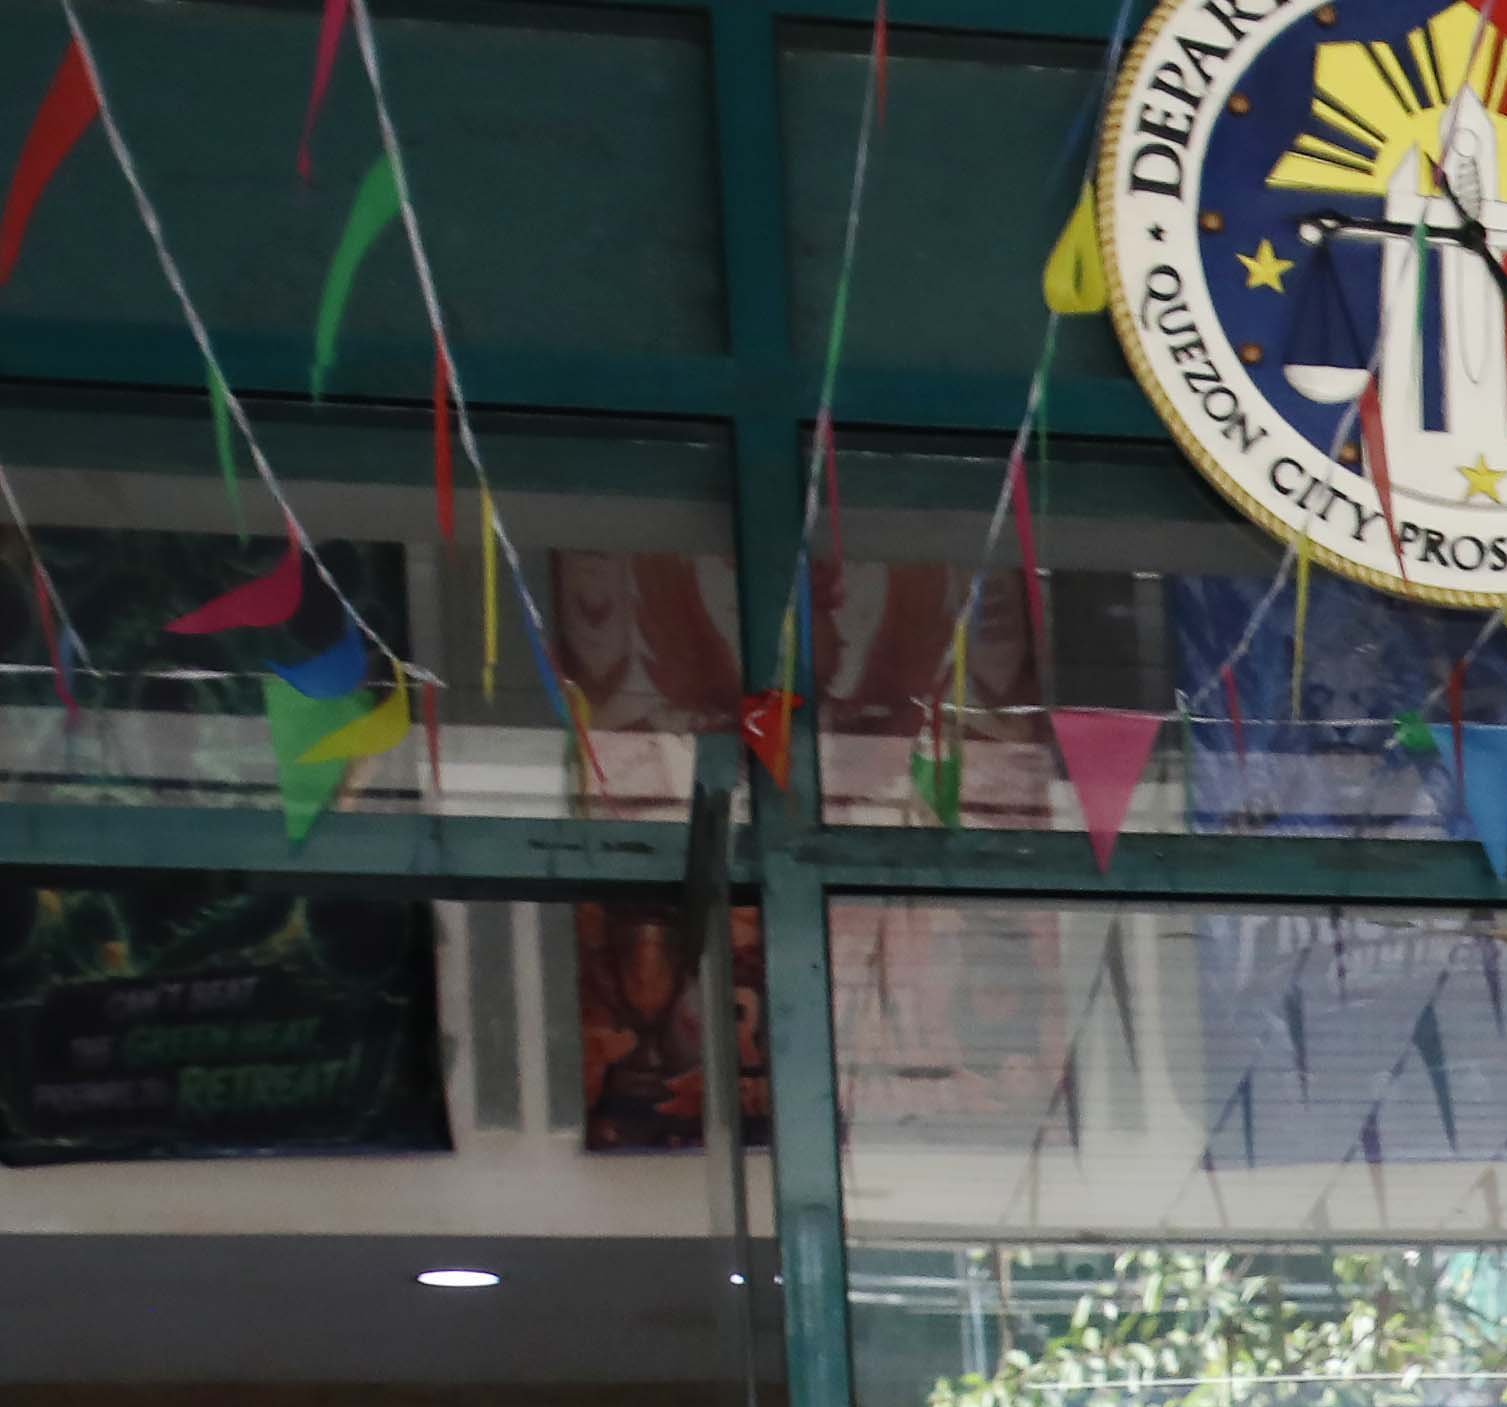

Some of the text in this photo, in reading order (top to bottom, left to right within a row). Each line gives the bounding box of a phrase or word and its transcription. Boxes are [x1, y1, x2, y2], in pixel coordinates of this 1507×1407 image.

[1128, 0, 1291, 201] DEPAR
[1139, 264, 1268, 453] QUEZON
[1268, 456, 1385, 543] CITY
